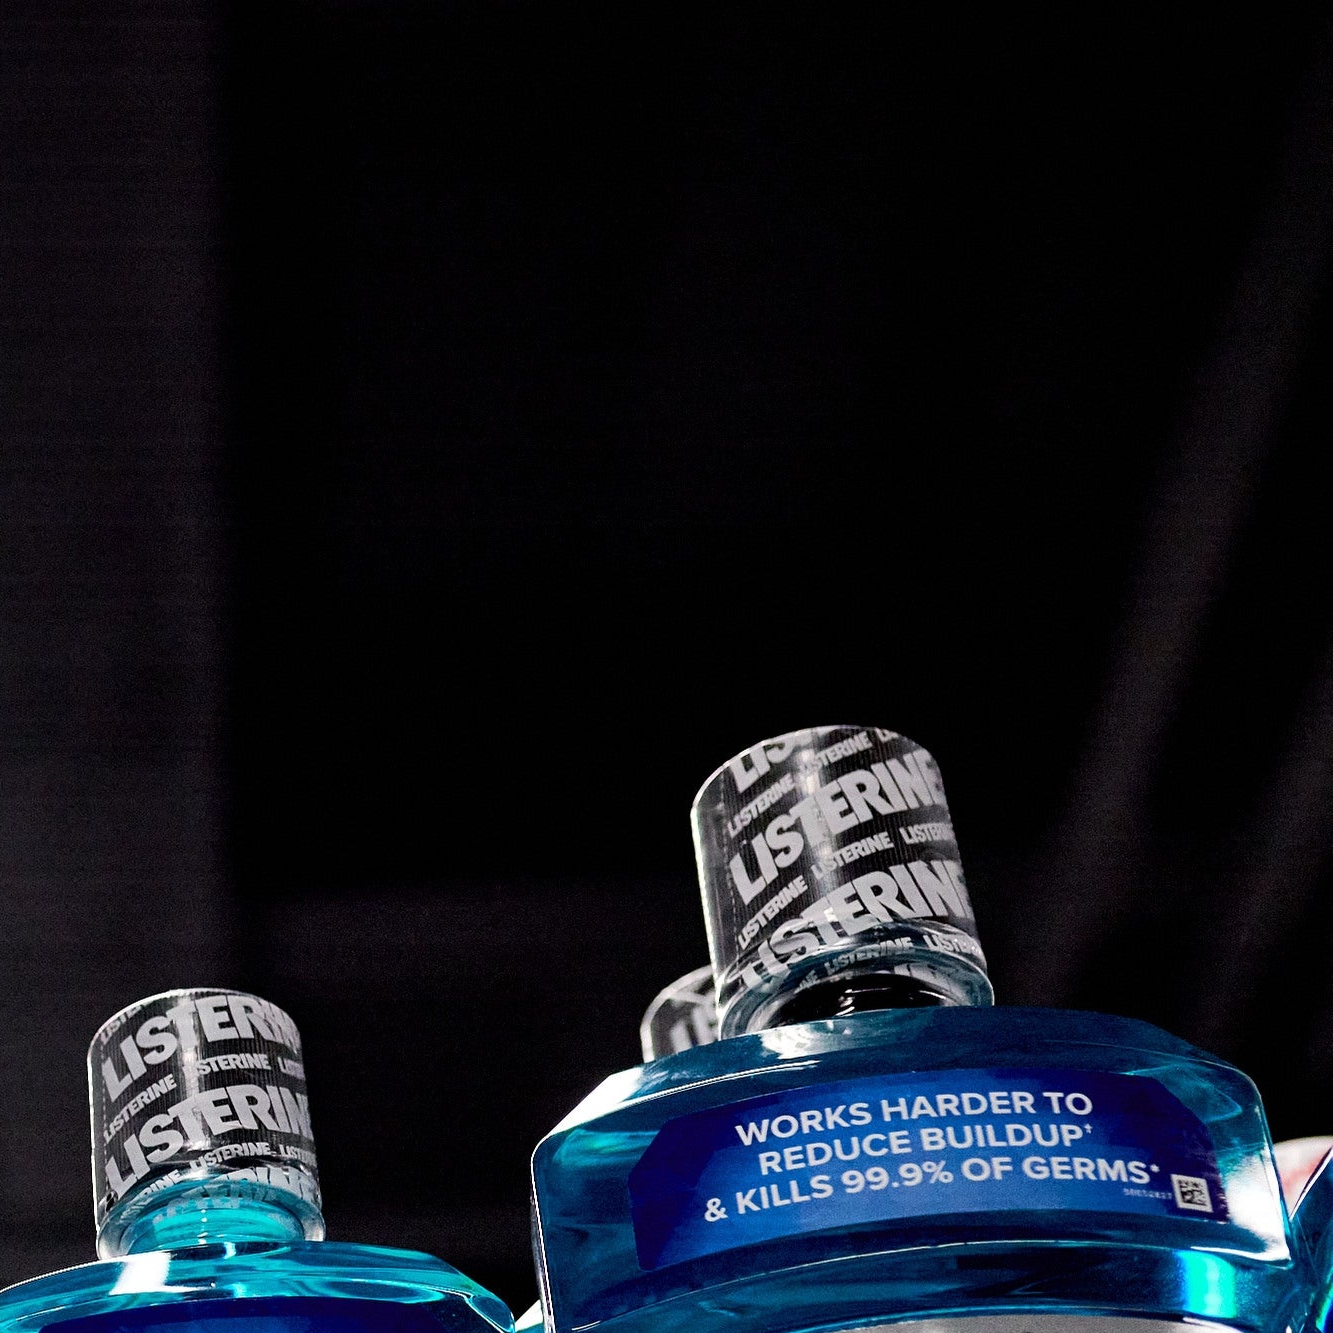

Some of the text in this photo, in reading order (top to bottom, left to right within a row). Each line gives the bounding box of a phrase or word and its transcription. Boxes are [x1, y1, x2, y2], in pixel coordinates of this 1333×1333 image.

[103, 1074, 177, 1144] LISTERINE
[735, 1092, 1093, 1147] WORKS HARDER TO
[758, 1131, 912, 1176] REDUCE
[703, 1195, 727, 1222] &
[736, 1174, 834, 1216] KILLS
[842, 1161, 954, 1194] 99.9%
[961, 1157, 1014, 1183] OF
